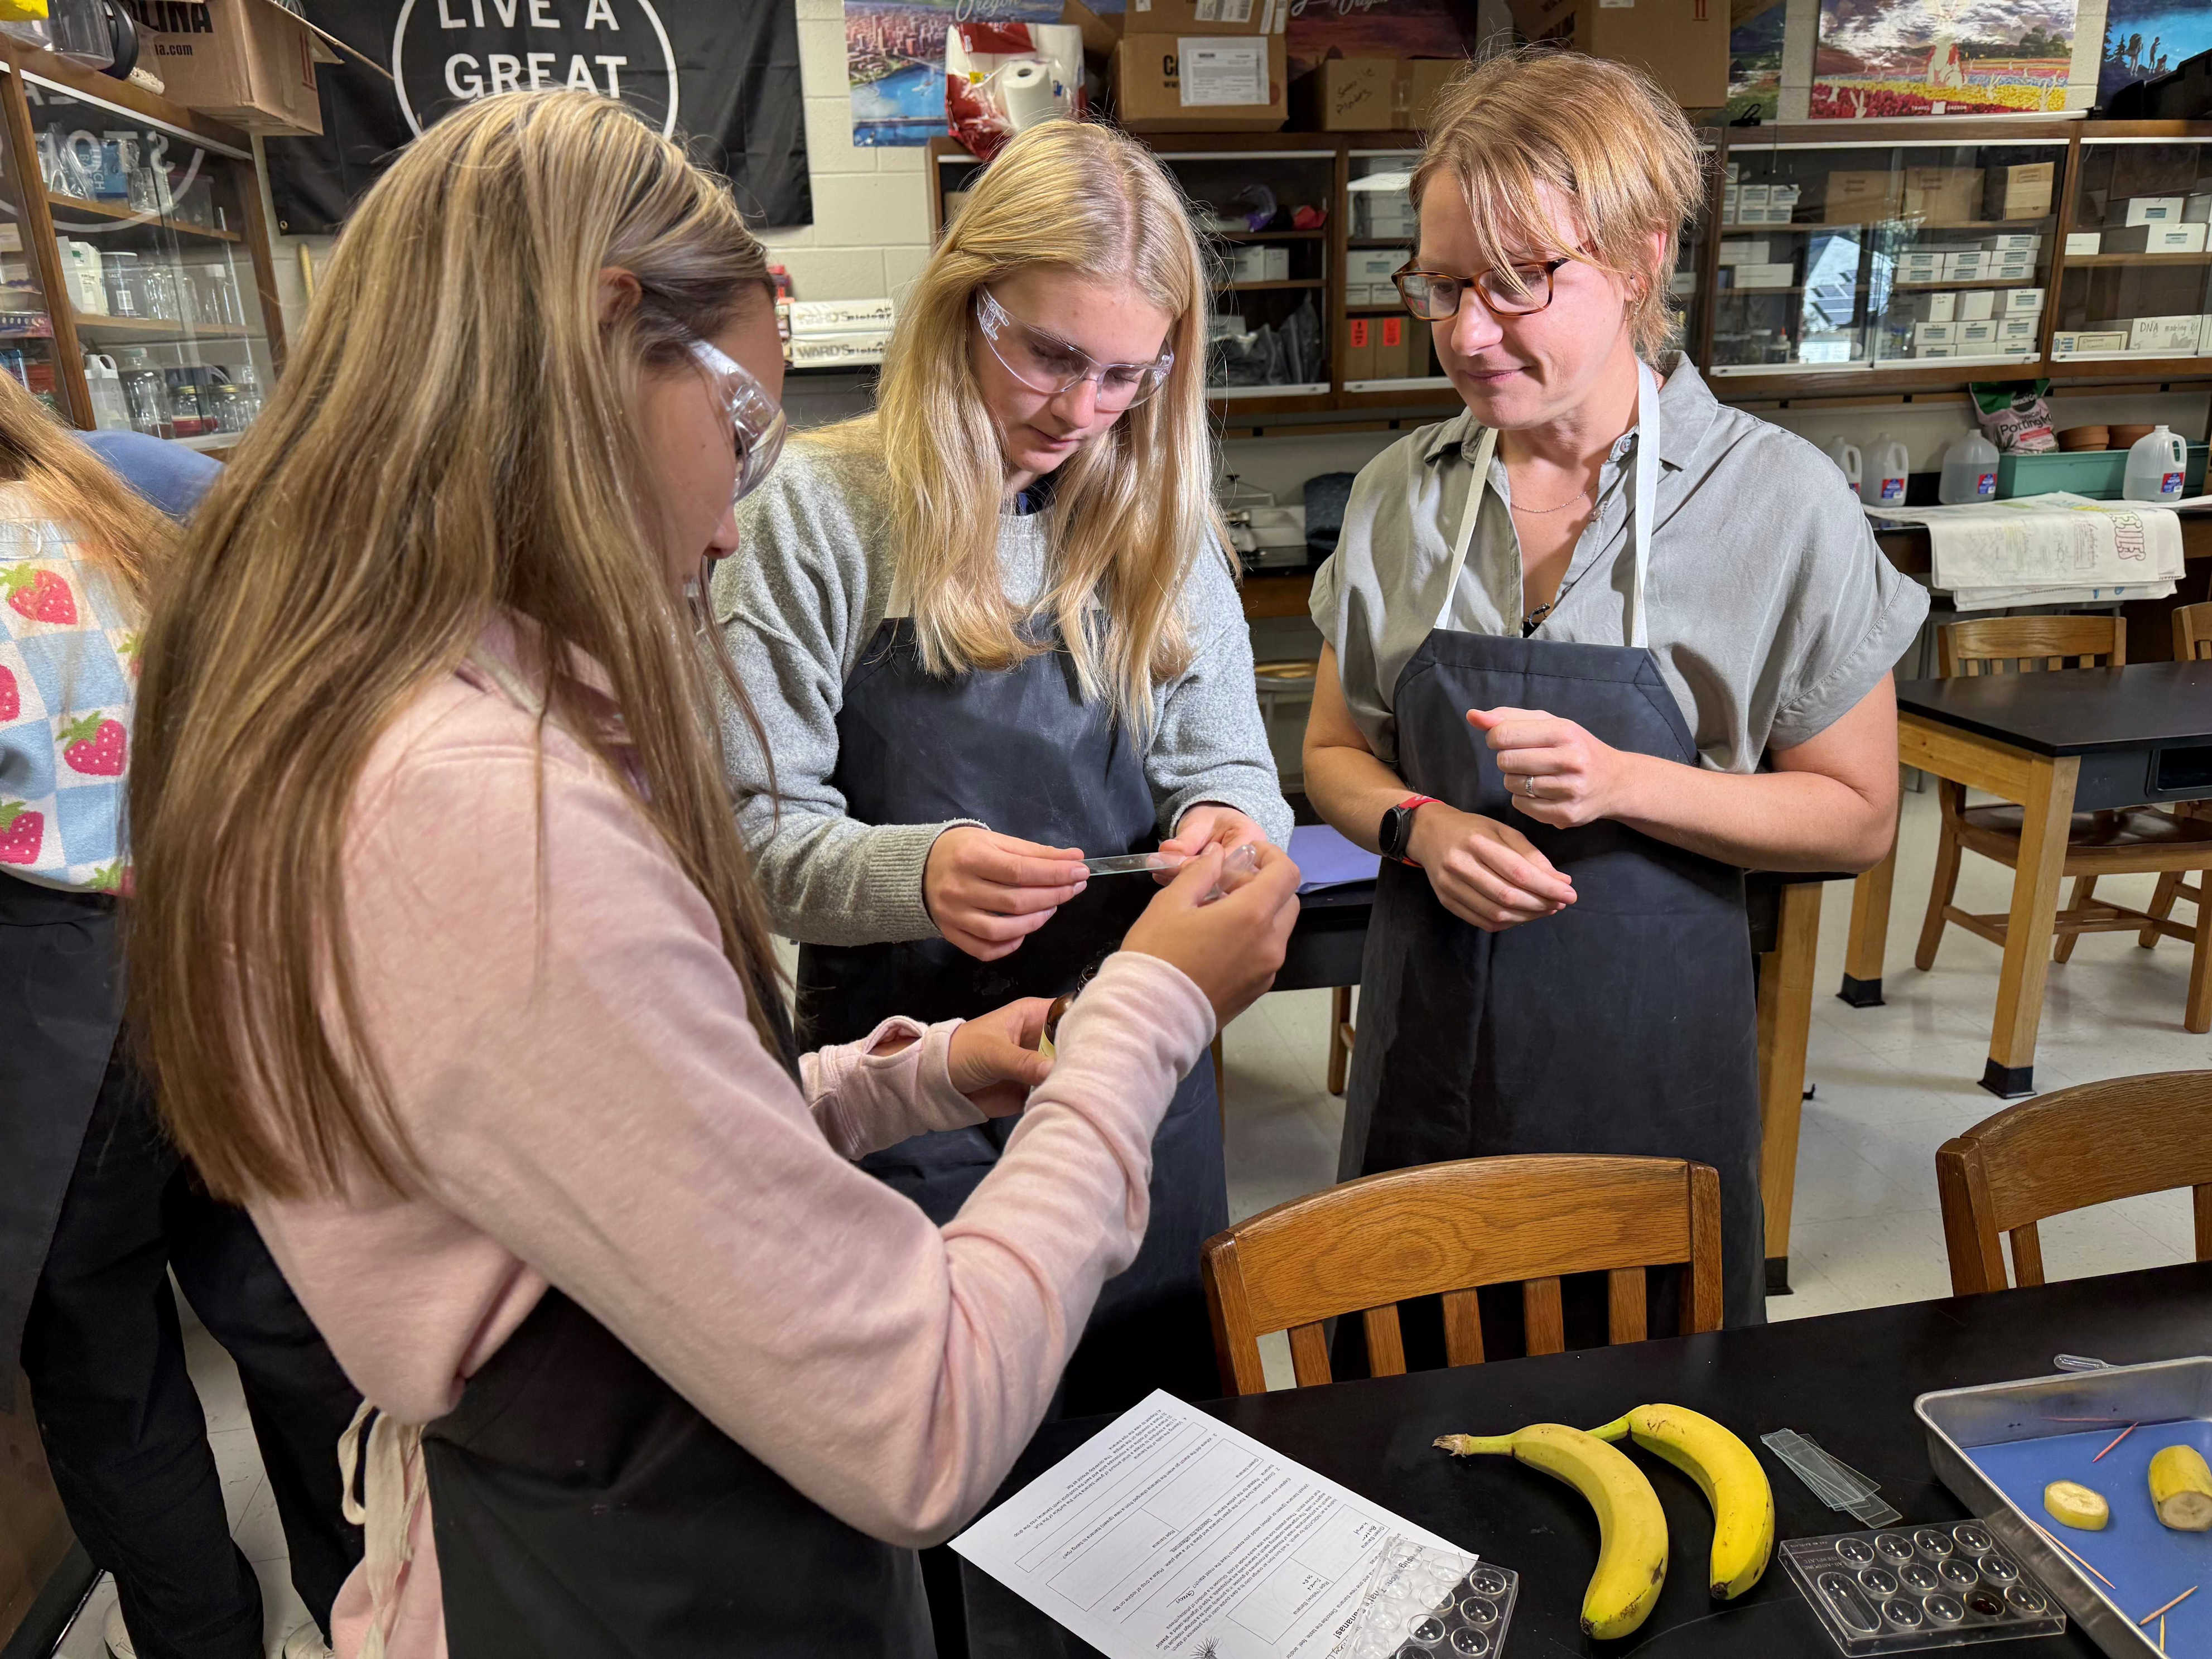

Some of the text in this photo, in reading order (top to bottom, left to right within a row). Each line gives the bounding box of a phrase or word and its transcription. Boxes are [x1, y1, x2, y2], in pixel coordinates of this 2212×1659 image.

[439, 0, 620, 30] LIVE A
[445, 52, 628, 99] GREAT
[2140, 322, 2158, 332] DNA
[2000, 416, 2043, 435] Potting
[1174, 1588, 1196, 1606] Green
